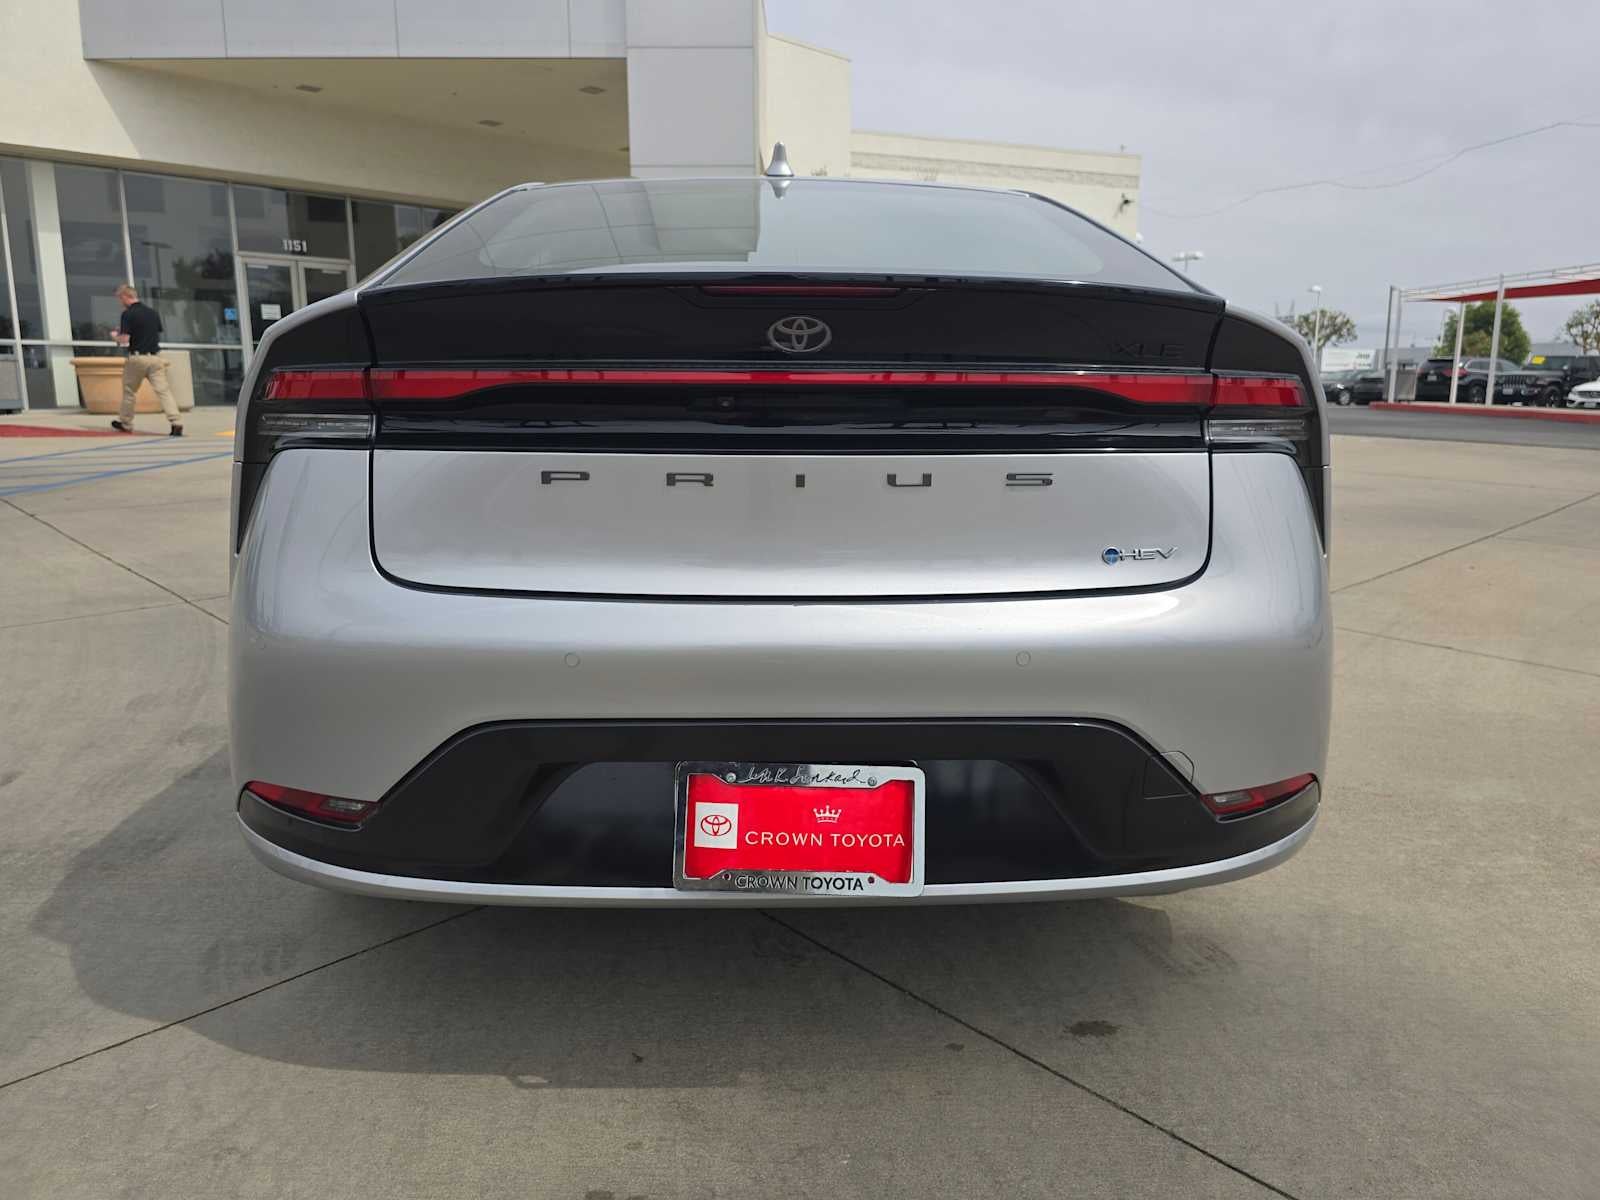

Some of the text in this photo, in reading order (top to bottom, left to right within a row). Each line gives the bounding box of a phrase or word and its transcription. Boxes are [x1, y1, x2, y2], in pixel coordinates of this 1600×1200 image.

[282, 239, 307, 253] 1151
[540, 470, 1053, 488] PRIUS
[1119, 547, 1178, 561] HEV
[744, 831, 906, 848] CROWN TOYOTA
[734, 874, 864, 891] CROWN TOYOTA
